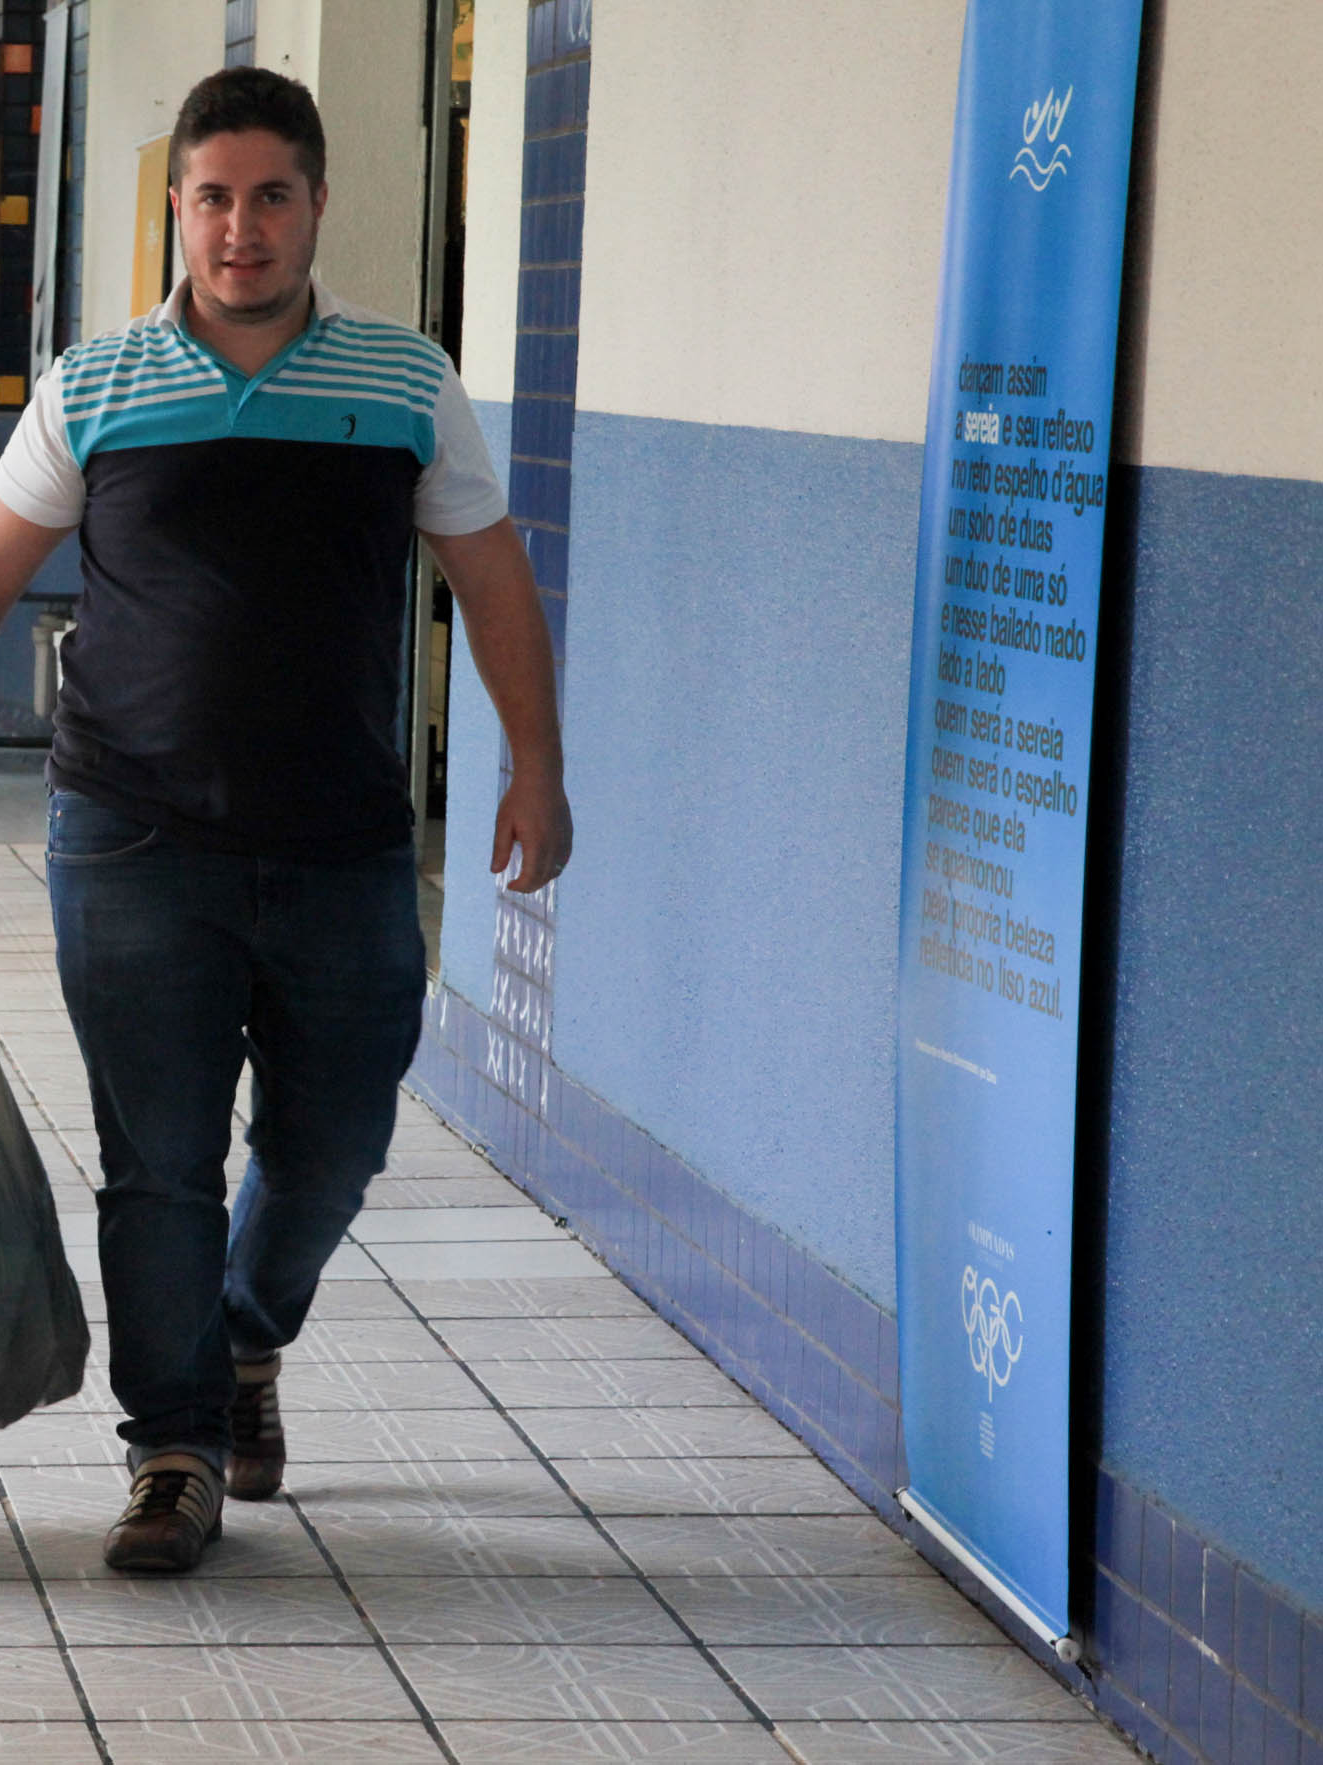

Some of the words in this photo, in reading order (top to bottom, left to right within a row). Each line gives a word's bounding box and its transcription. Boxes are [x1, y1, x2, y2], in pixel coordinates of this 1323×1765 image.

[959, 353, 1003, 404] dançam
[1007, 357, 1047, 397] assim
[955, 410, 963, 441] a
[964, 403, 999, 444] sereia
[1003, 414, 1012, 444] e
[1016, 416, 1039, 448] seu
[1042, 408, 1094, 453] reflexo
[952, 458, 966, 490] no
[967, 456, 991, 493] reto
[994, 457, 1047, 507] espelho
[1051, 459, 1104, 516] d'água
[948, 506, 965, 538] um
[967, 503, 994, 543] solo
[998, 505, 1016, 546] de
[1019, 508, 1053, 552] duas
[945, 554, 963, 586] um
[964, 551, 988, 592] duo
[992, 556, 1011, 596] de
[1015, 566, 1044, 601] uma
[1047, 564, 1067, 607] só
[941, 603, 950, 632] e
[951, 605, 986, 642] nesse
[990, 605, 1041, 652] bailado
[1045, 618, 1086, 662] nado
[938, 641, 961, 684] lado
[964, 657, 972, 687] a
[976, 650, 1005, 696] lado
[934, 699, 967, 740] quem
[970, 703, 1001, 745] será
[1005, 714, 1014, 747] a
[1017, 717, 1064, 761] sereia
[931, 747, 964, 789] quem
[968, 753, 998, 794] será
[1002, 768, 1011, 797] o
[1016, 770, 1078, 817] espelho
[927, 794, 970, 834] parece
[972, 811, 1001, 849] que
[1003, 815, 1025, 852] ela
[925, 840, 941, 872] se
[942, 846, 1014, 900] apaixonou
[922, 886, 948, 924] pela
[951, 893, 1002, 943] própria
[1005, 909, 1056, 965] beleza
[976, 957, 994, 992] no
[998, 955, 1024, 1004] liso
[1029, 976, 1064, 1020] azul.
